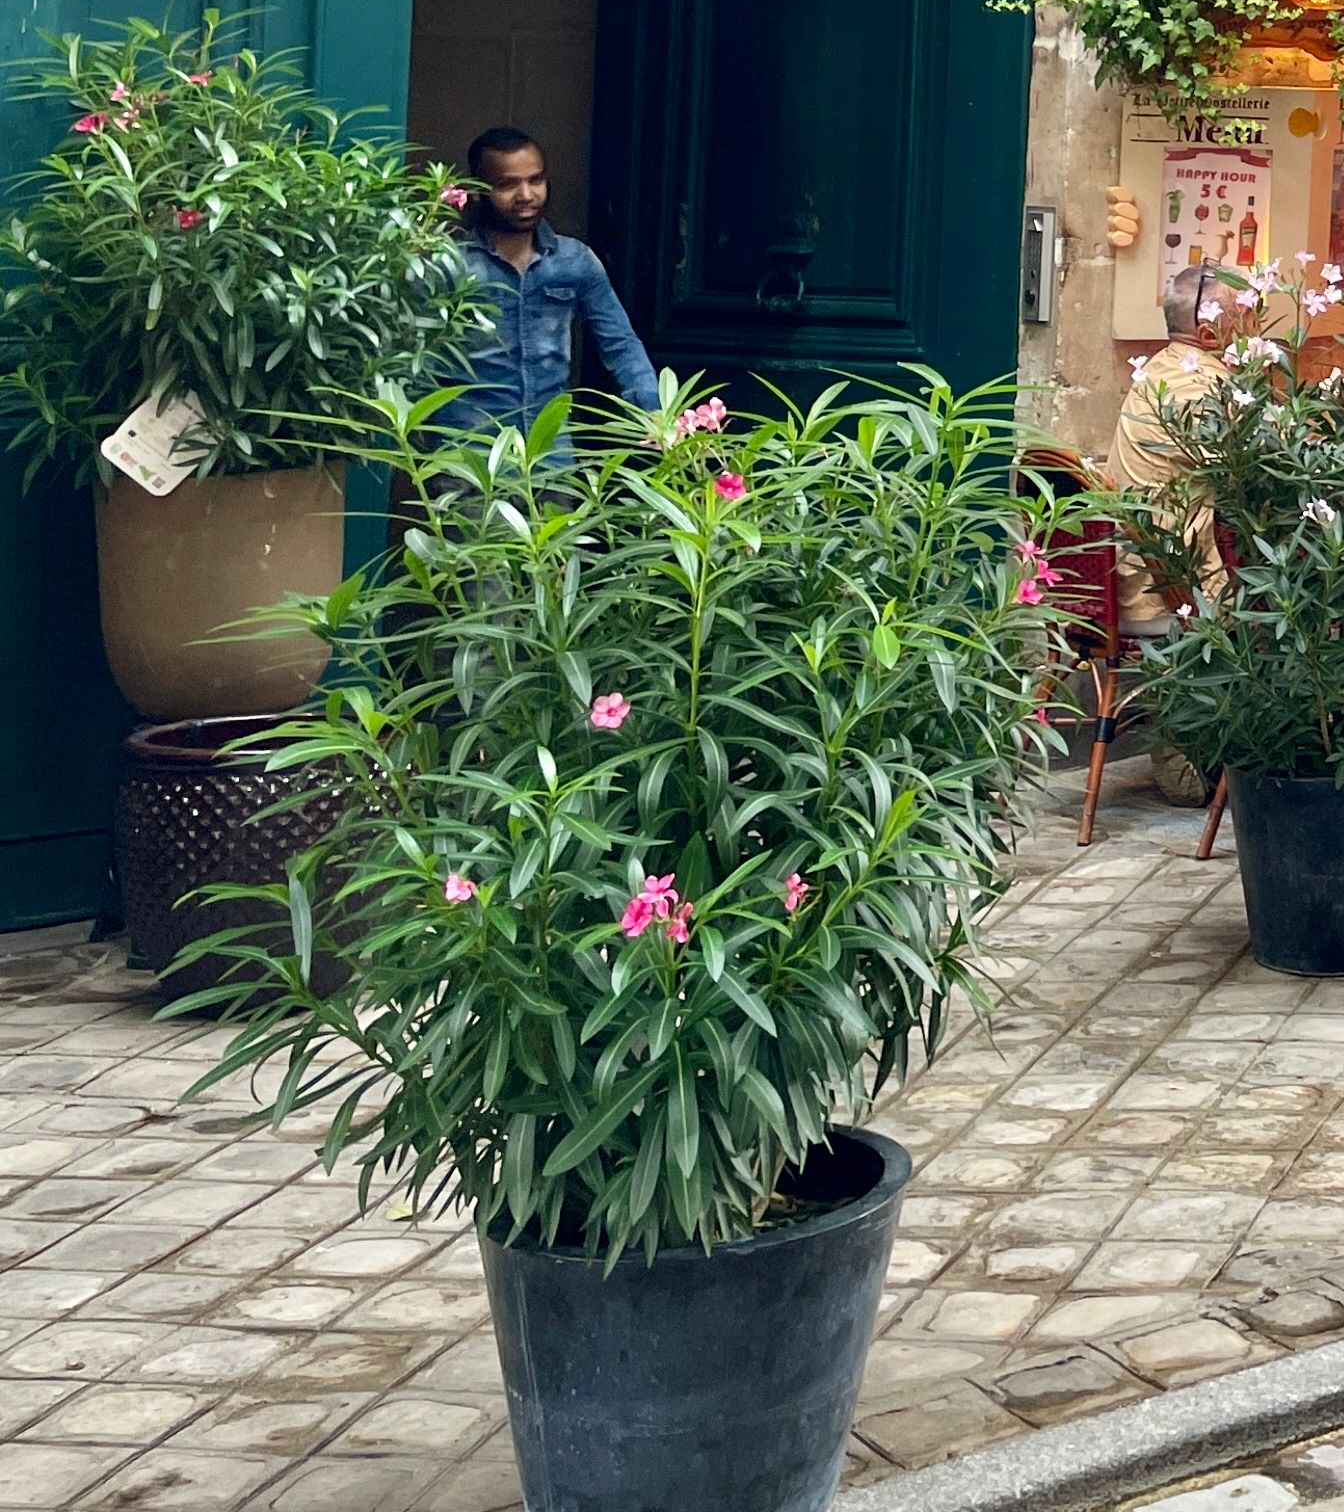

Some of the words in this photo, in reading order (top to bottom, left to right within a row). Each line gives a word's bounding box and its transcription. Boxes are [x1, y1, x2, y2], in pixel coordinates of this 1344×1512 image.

[1176, 169, 1217, 181] HAPPY
[1220, 170, 1256, 183] HOUR
[1201, 184, 1210, 198] 5
